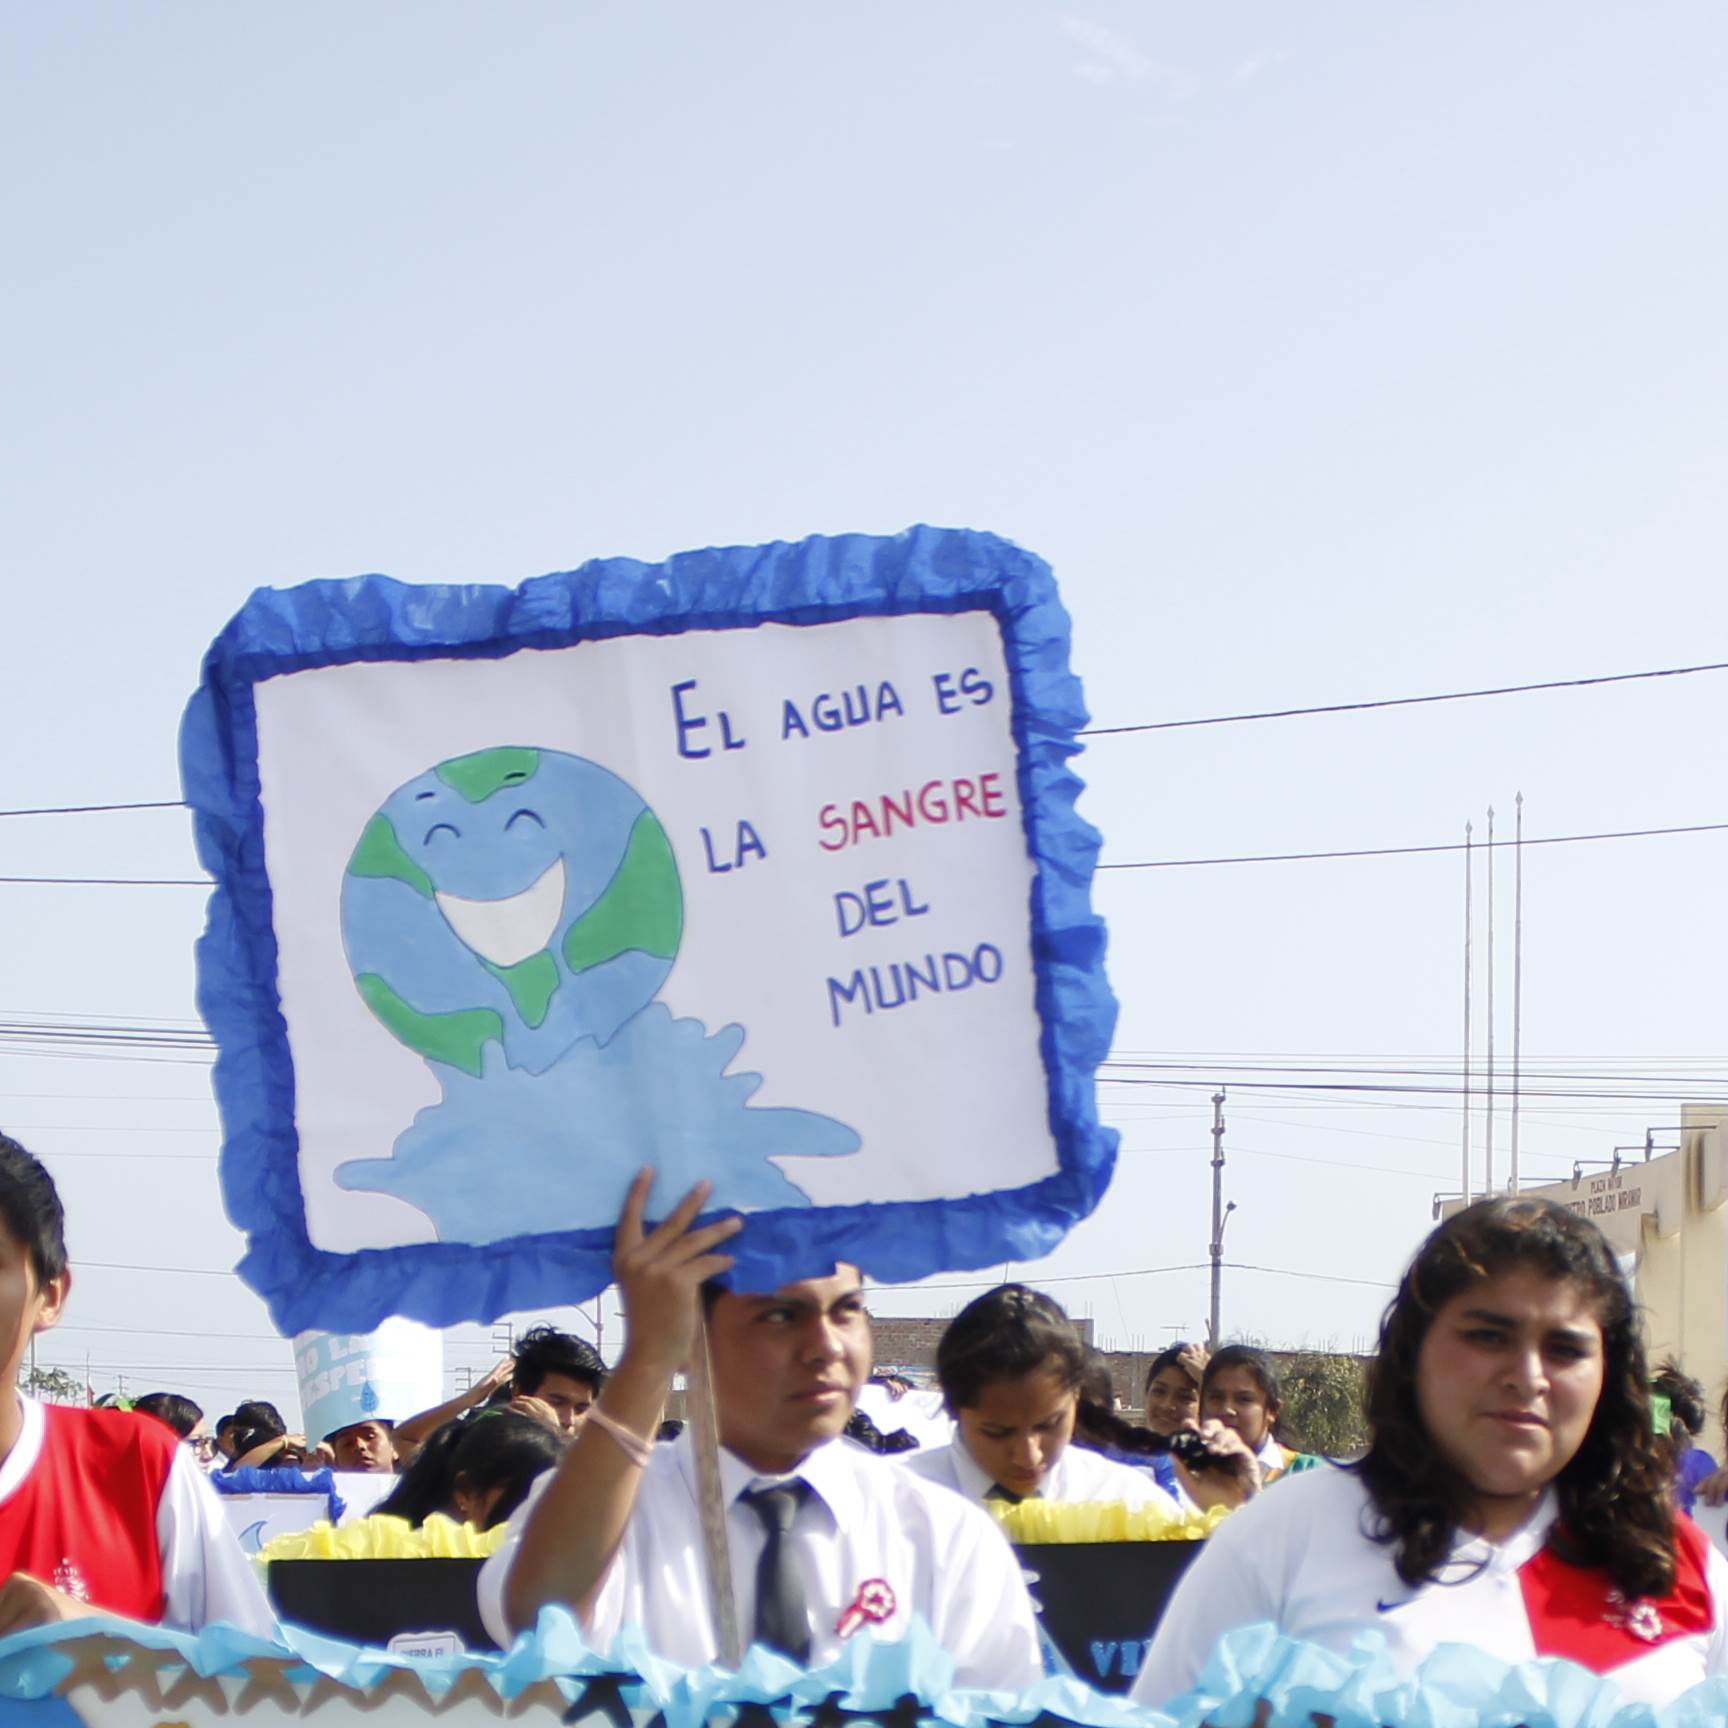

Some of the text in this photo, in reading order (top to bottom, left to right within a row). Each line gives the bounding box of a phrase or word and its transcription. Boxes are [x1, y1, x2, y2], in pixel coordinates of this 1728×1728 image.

[671, 666, 996, 760] EL AGUA ES
[699, 771, 1010, 874] LA SANGRE
[833, 877, 931, 938] DEL
[826, 941, 1006, 1027] MUNDO
